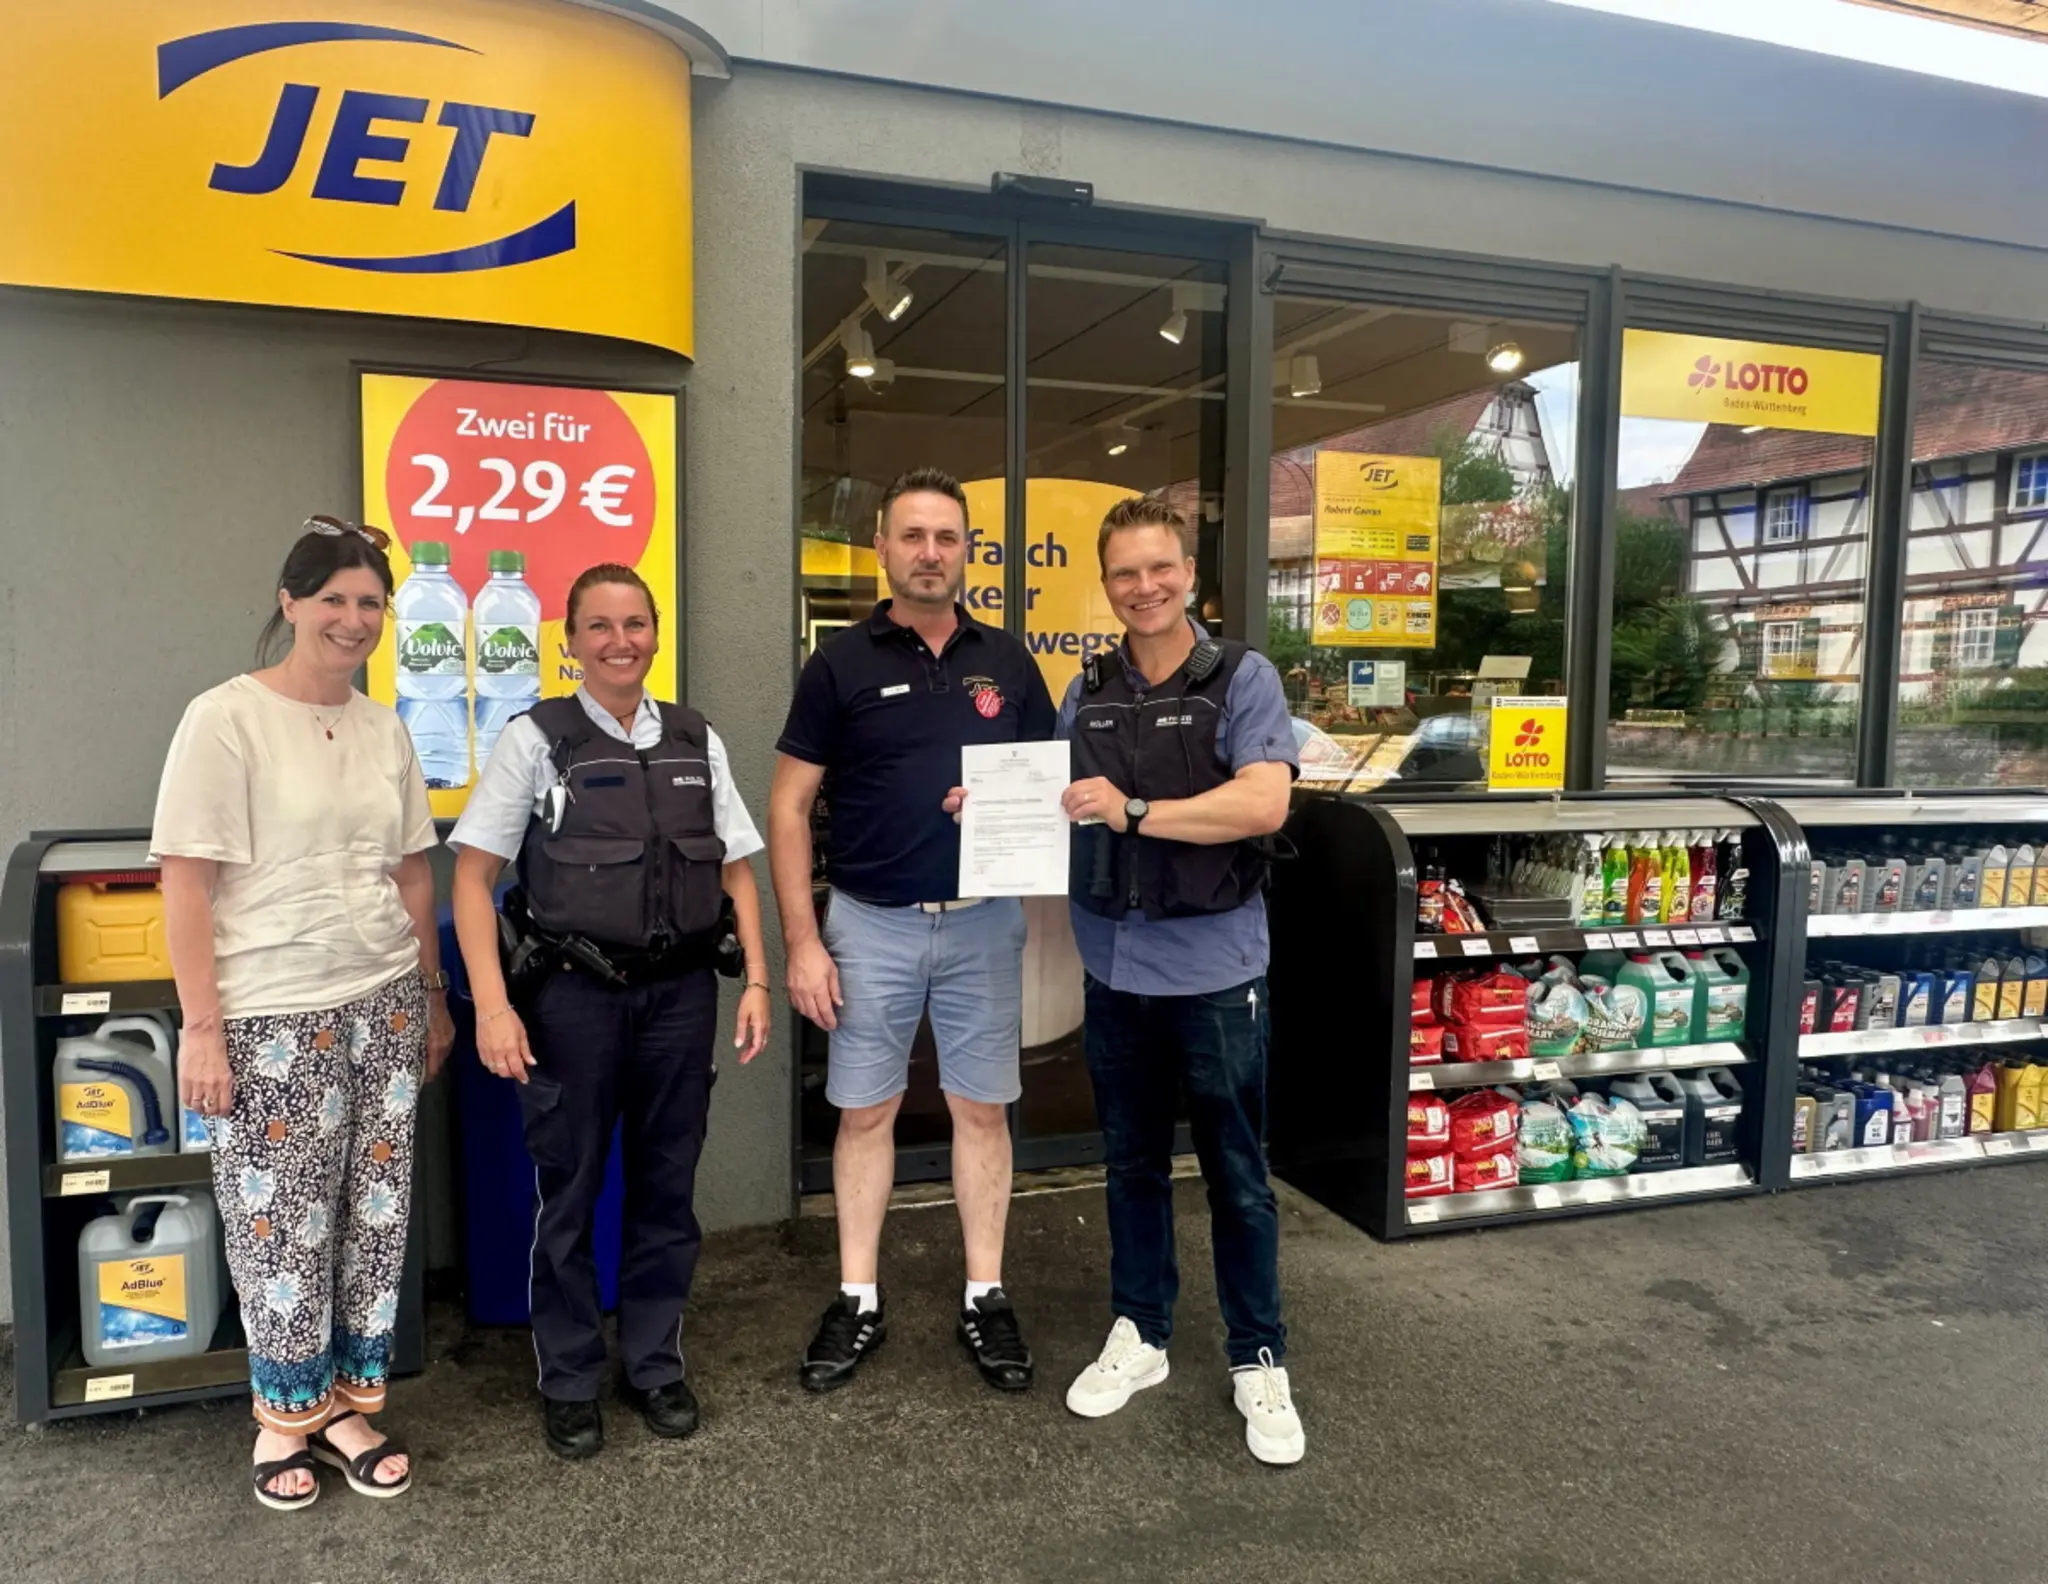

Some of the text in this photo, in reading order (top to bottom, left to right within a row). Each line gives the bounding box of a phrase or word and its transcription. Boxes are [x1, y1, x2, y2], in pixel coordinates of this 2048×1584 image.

[208, 82, 536, 213] JET
[1725, 361, 1808, 396] LOTTO
[1723, 397, 1808, 416] Baden-Württemberg
[456, 407, 591, 442] Zwei für
[1364, 468, 1395, 483] JET
[410, 453, 636, 535] 2,29 €
[966, 528, 1068, 568] fach
[966, 584, 1041, 610] ker
[406, 638, 461, 656] Volvic
[484, 641, 535, 658] Volvic
[1026, 631, 1120, 660] wegs
[559, 664, 586, 681] Na
[1505, 752, 1550, 767] LOTTO
[121, 1278, 164, 1292] AdBlue
